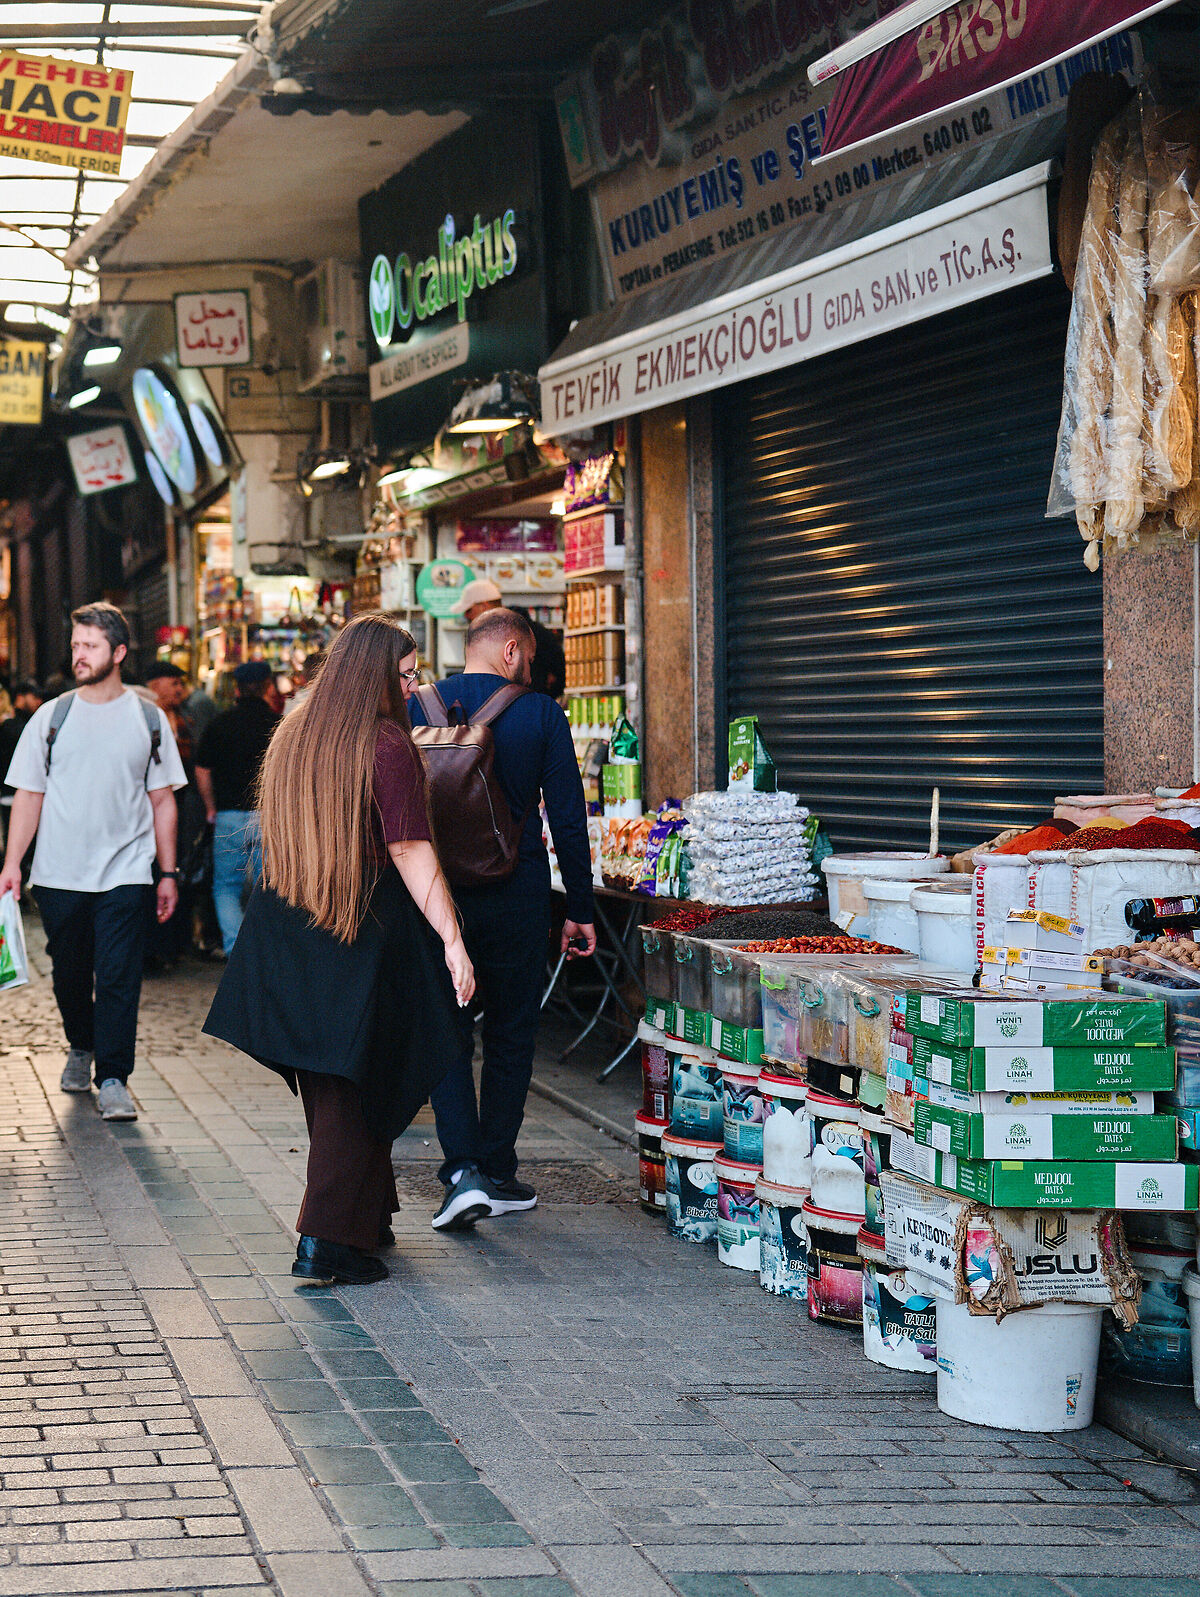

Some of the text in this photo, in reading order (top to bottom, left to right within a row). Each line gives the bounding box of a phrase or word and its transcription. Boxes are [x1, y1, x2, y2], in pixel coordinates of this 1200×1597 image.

[923, 125, 951, 156] 640
[971, 106, 993, 136] 02
[608, 155, 743, 257] KURUYEMİŞ
[751, 149, 780, 186] ve
[188, 300, 236, 325] محل
[182, 319, 246, 356] أوباما
[552, 360, 622, 421] TEVFİK
[634, 292, 813, 395] EKMEKÇİOĞLU
[824, 288, 866, 330] GIDA
[1094, 1053, 1134, 1066] MEDJOOL
[1006, 1070, 1033, 1078] LINAH
[1104, 1066, 1123, 1075] DATES
[1093, 1121, 1134, 1134] MEDJOOL
[1005, 1137, 1031, 1145] LINAH
[1104, 1134, 1123, 1143] DATES
[1034, 1172, 1074, 1185] MEDJOOL
[1045, 1185, 1064, 1195] DATES
[1137, 1191, 1163, 1199] LINAH
[686, 1205, 708, 1218] Biber
[1012, 1254, 1098, 1276] USLU
[904, 1312, 935, 1327] TATLI
[886, 1322, 914, 1338] Biber
